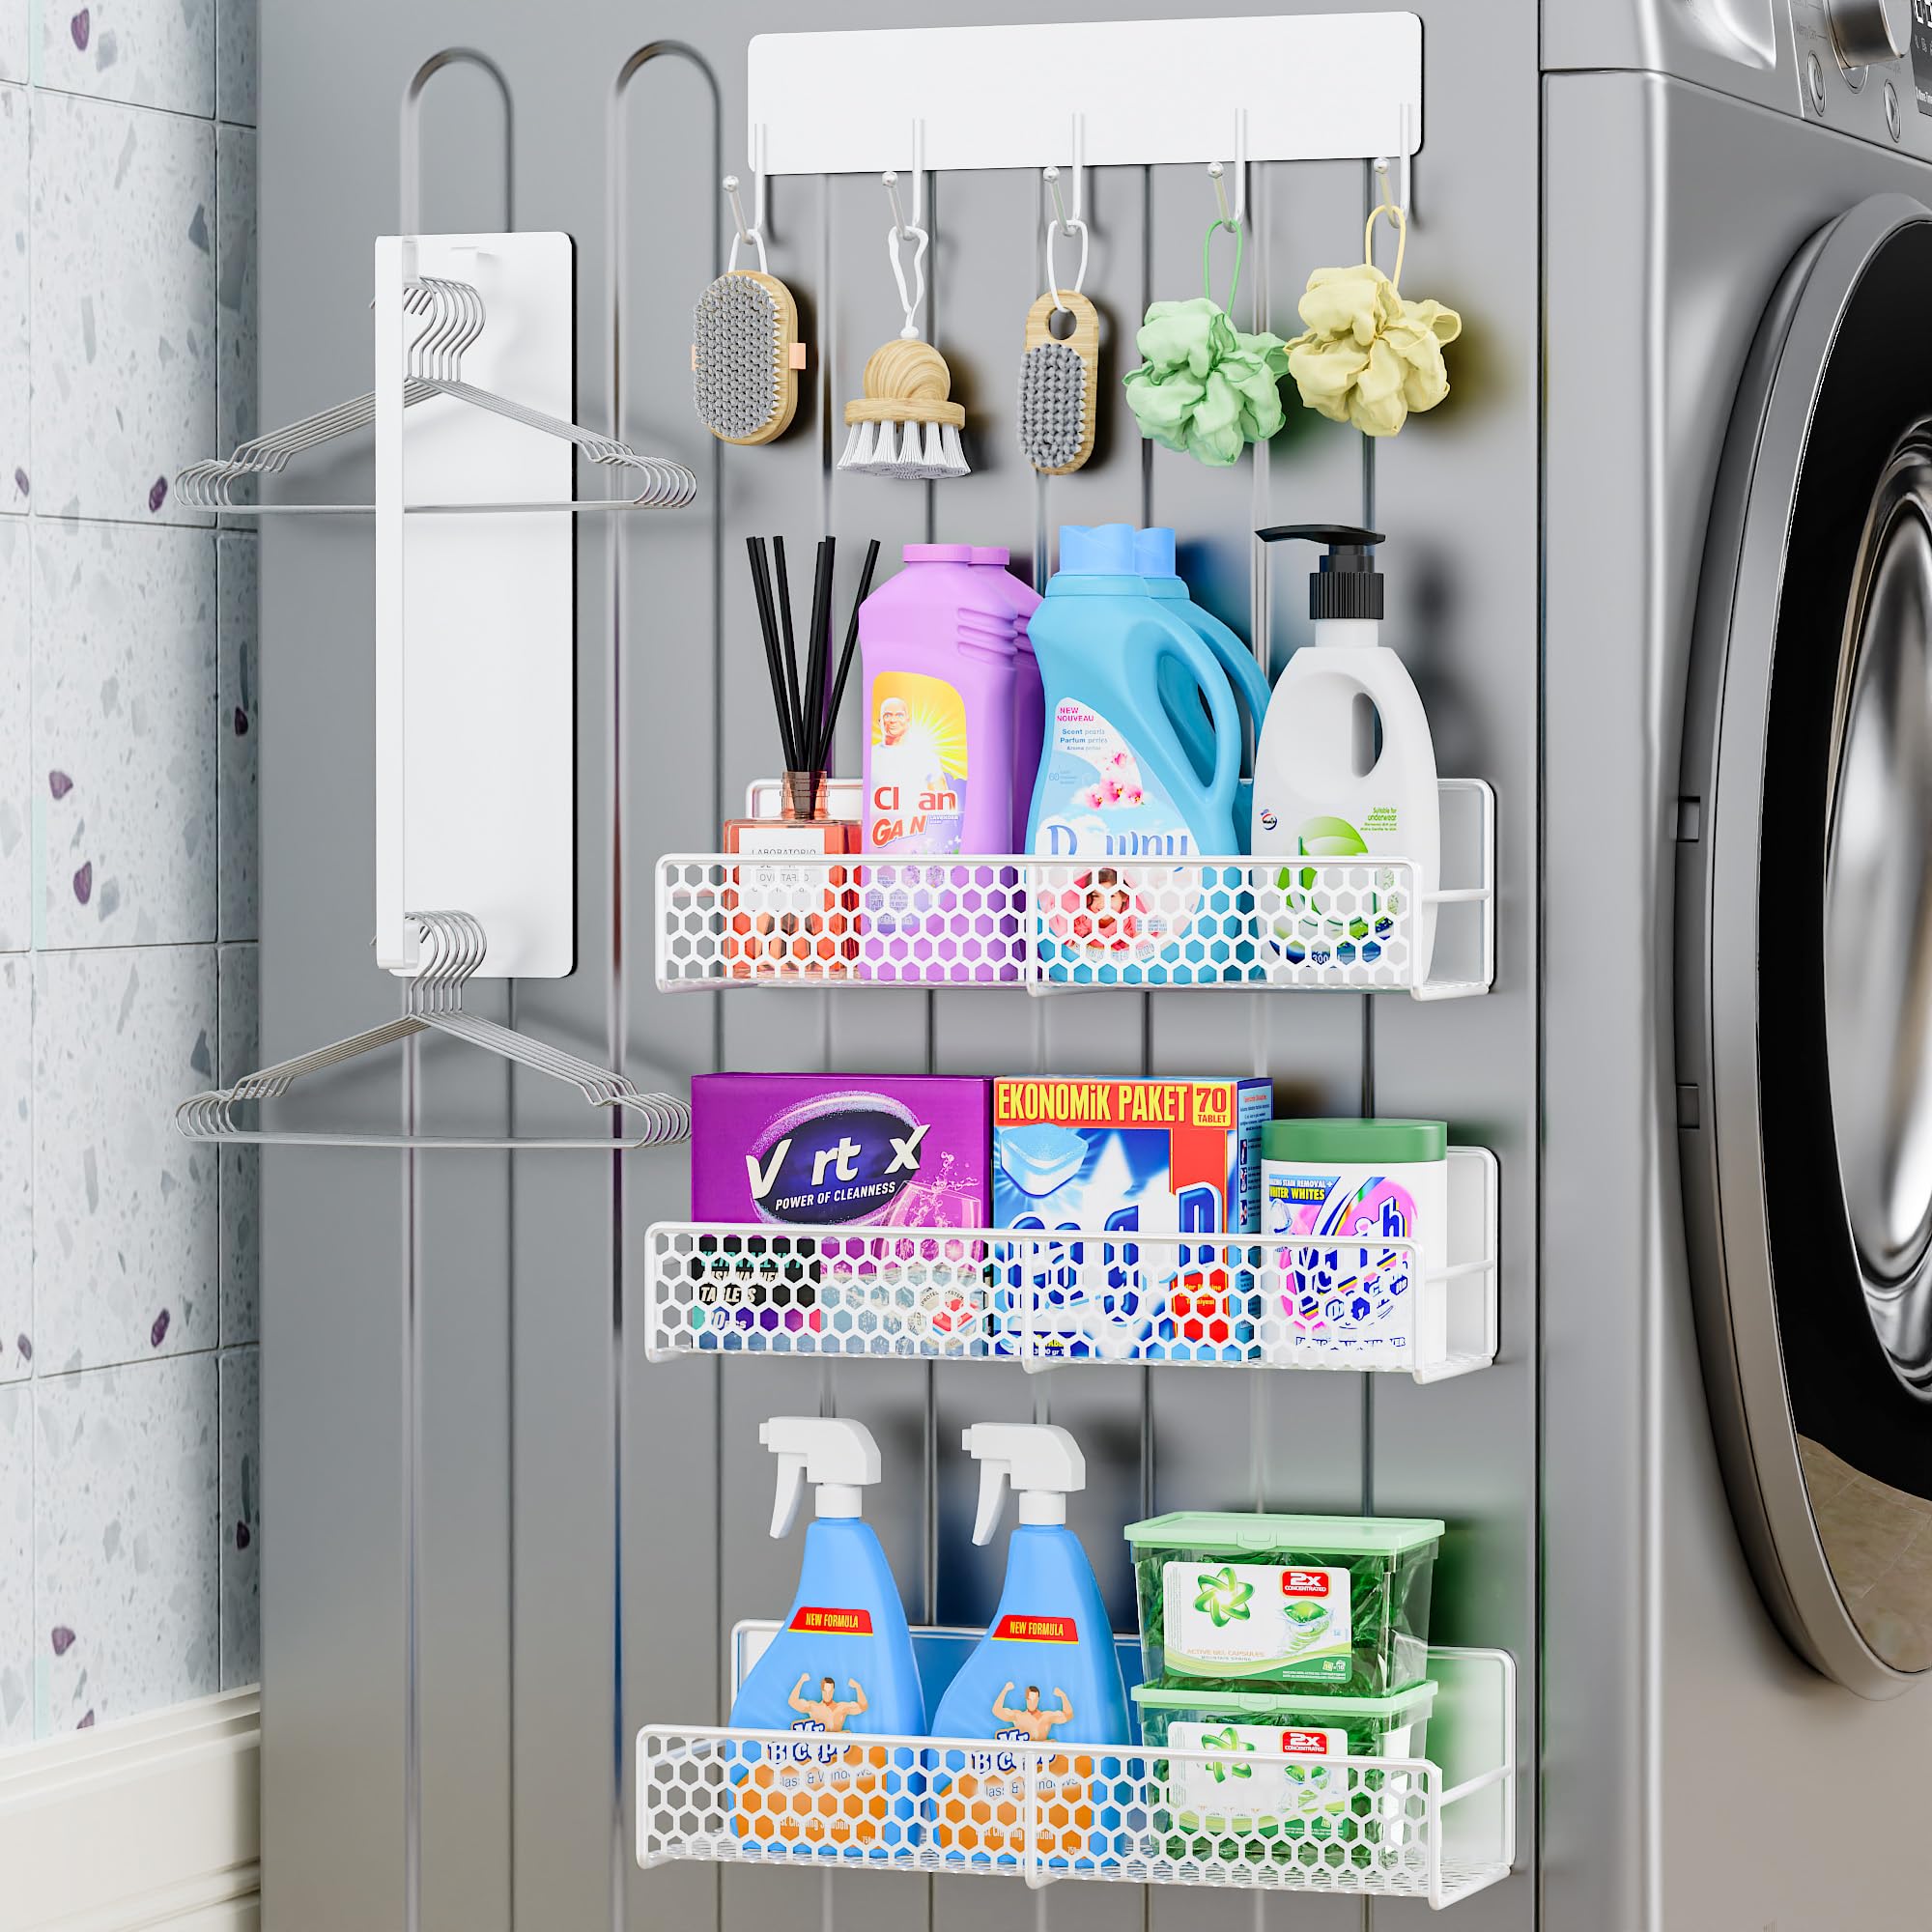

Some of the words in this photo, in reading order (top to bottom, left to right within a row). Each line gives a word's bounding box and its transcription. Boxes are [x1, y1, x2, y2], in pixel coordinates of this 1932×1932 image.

[1119, 1084, 1188, 1122] PAKET
[1196, 1087, 1228, 1113] 70
[1197, 1114, 1228, 1123] TABLET
[1297, 1179, 1326, 1188] REMOVAL
[775, 1194, 814, 1211] POWER
[816, 1191, 832, 1205] OF
[834, 1180, 896, 1202] CLEANNESS
[1291, 1187, 1325, 1201] WHITES
[700, 1287, 757, 1303] TALES
[805, 1612, 821, 1628] NEW
[823, 1613, 859, 1629] FORMULA
[1009, 1621, 1027, 1634] NEW
[1028, 1622, 1065, 1636] FORMULA
